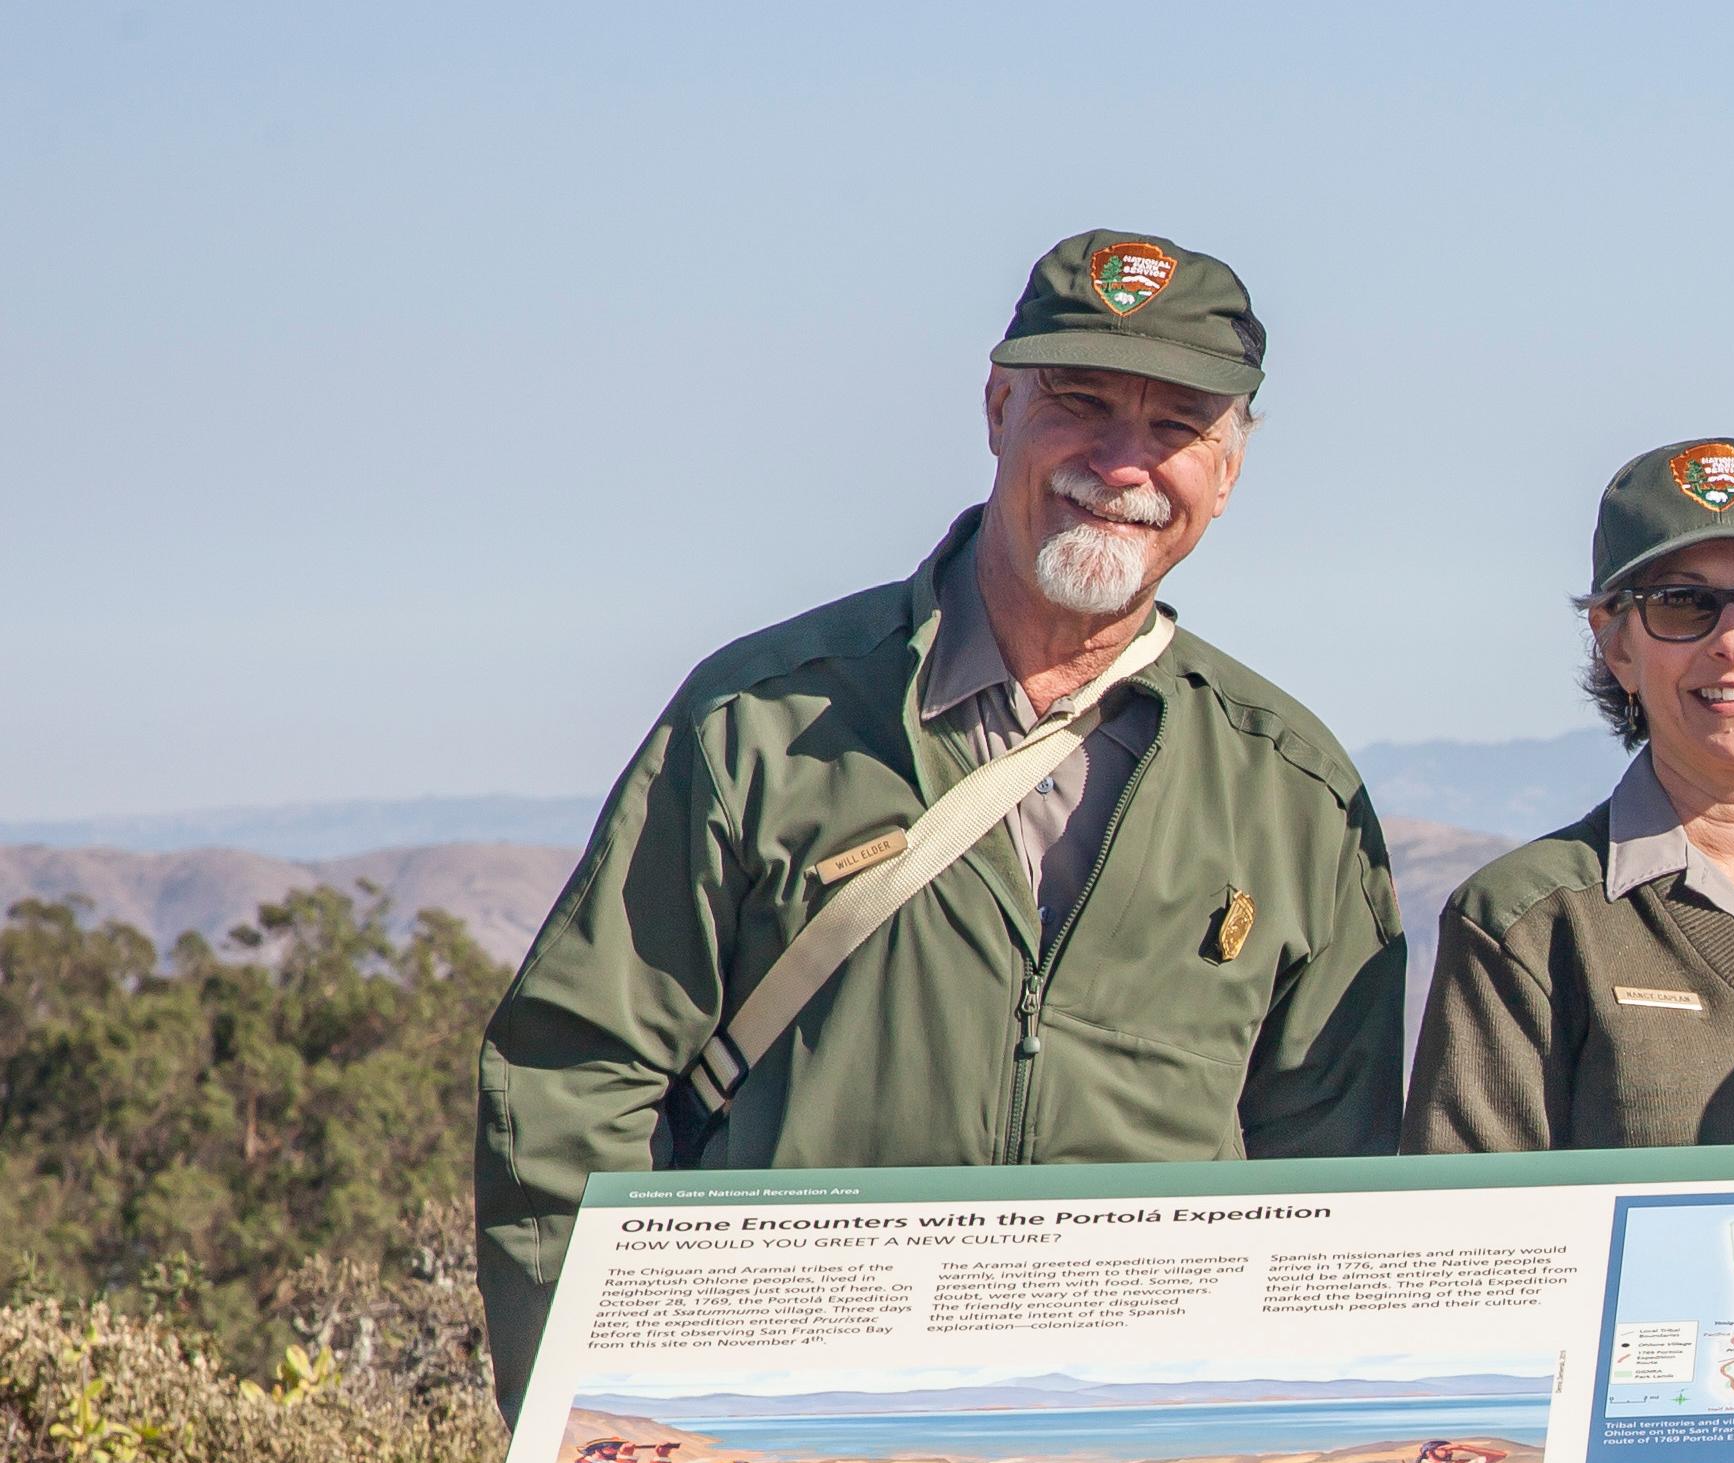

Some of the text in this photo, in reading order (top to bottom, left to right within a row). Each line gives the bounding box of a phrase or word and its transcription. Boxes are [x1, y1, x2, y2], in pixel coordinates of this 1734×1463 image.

[1123, 255, 1171, 269] NATIONAL
[1123, 266, 1166, 278] SERVICE
[835, 841, 890, 870] WILL ELDER
[629, 1190, 672, 1198] Golden
[708, 1189, 760, 1197] National
[762, 1188, 827, 1196] Recreation
[830, 1187, 859, 1195] Area
[621, 1205, 1330, 1232] Ohlone Encounters with the Portolá Expedition
[615, 1233, 1061, 1250] HOW WOULD YOU GREET A NEW CULTURE?
[1271, 1245, 1566, 1263] Spanish missionaries and military would
[608, 1268, 635, 1276] The
[640, 1268, 702, 1277] Chiguan
[707, 1266, 736, 1274] and
[740, 1265, 795, 1273] Aramai
[801, 1264, 842, 1272] tribes
[847, 1263, 863, 1272] of
[1268, 1263, 1311, 1271] arrive
[1337, 1261, 1373, 1270] 1776,
[1379, 1260, 1407, 1268] and
[1441, 1258, 1489, 1266] Native
[1494, 1256, 1551, 1266] peoples
[604, 1277, 687, 1287] Ramaytush
[692, 1276, 748, 1285] Ohlone
[752, 1275, 814, 1285] peoples,
[821, 1274, 857, 1282] lived
[602, 1288, 692, 1298] neighboring
[697, 1287, 750, 1296] villages
[753, 1287, 779, 1296] just
[784, 1285, 825, 1293] south
[830, 1284, 845, 1292] of
[850, 1284, 887, 1292] here.
[1639, 1419, 1695, 1428] territories
[1697, 1418, 1720, 1426] and
